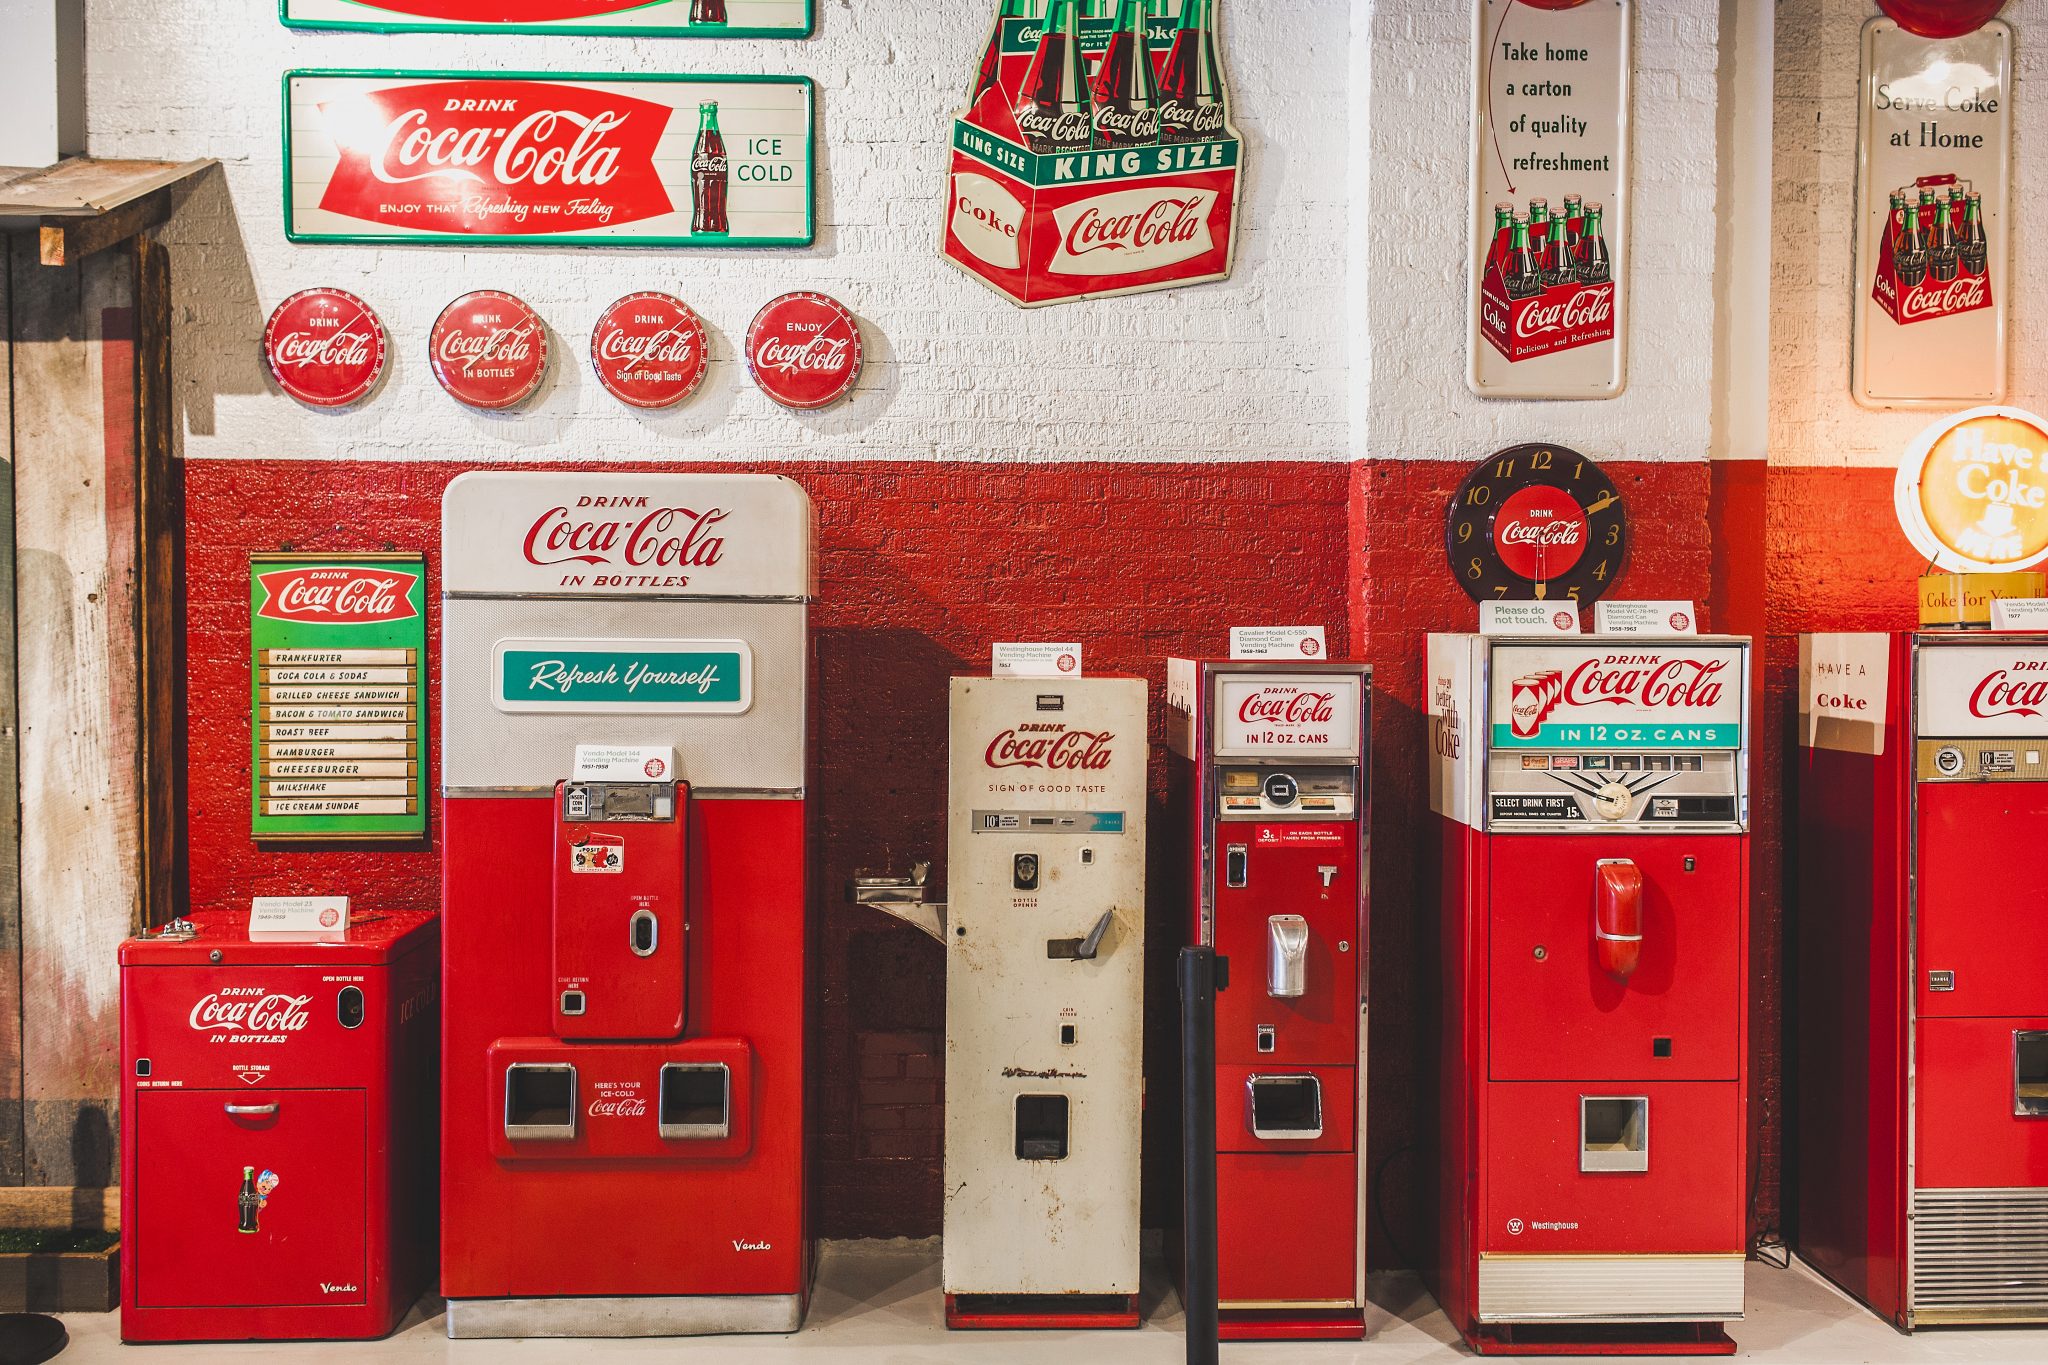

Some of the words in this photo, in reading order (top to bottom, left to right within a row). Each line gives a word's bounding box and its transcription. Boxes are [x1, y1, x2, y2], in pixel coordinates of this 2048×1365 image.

[1502, 42, 1538, 61] Take
[1545, 42, 1588, 61] home
[1506, 83, 1515, 96] a
[1522, 80, 1572, 97] carton
[443, 99, 518, 112] DRINK
[1876, 84, 1937, 111] Serve
[1944, 86, 1999, 113] Coke
[1017, 105, 1090, 141] Coca-Cola
[1509, 114, 1527, 133] of
[1531, 114, 1588, 138] quality
[1890, 129, 1911, 147] at
[1919, 121, 1984, 148] Home
[369, 108, 632, 185] Coca-Cola
[748, 139, 782, 155] ICE
[962, 131, 992, 156] KING
[996, 148, 1026, 172] SIZE
[1054, 151, 1142, 181] KING
[1156, 144, 1224, 171] SIZE
[1513, 152, 1610, 171] refreshment
[737, 165, 793, 182] COLD
[380, 204, 421, 214] ENJOY
[426, 204, 457, 213] THAT
[462, 195, 529, 222] Refreshing
[533, 205, 560, 214] NEW
[563, 198, 614, 223] Feeling
[958, 196, 1016, 239] Coke
[1065, 195, 1205, 256] Coca-Cola
[1876, 274, 1895, 300] Coke
[1902, 276, 1986, 318] Coca-Cola
[635, 315, 664, 324] DRINK
[1483, 302, 1507, 334] Coke
[1516, 286, 1613, 338] Coca-Cola
[309, 318, 340, 328] DRINK
[786, 323, 823, 332] ENJOY
[601, 328, 696, 362] Coca-Cola
[1516, 343, 1549, 356] Delicious
[1553, 337, 1568, 347] and
[1571, 328, 1611, 342] Refreshing
[463, 369, 474, 378] IN
[477, 368, 515, 378] BOTTLES
[616, 370, 633, 382] Sign
[635, 371, 642, 380] of
[643, 371, 662, 382] Good
[664, 371, 682, 381] Taste
[1952, 428, 2033, 468] Have
[1495, 459, 1515, 478] 11
[1529, 451, 1553, 470] 12
[1574, 461, 1583, 480] 1
[1467, 485, 1490, 506] 10
[1957, 464, 2046, 509] Coke
[576, 495, 650, 508] DRINK
[1529, 509, 1553, 518] DRINK
[523, 506, 733, 567] Coca-Cola
[1458, 522, 1472, 544] 9
[1606, 524, 1620, 545] 3
[1467, 557, 1482, 579] 8
[1592, 559, 1608, 581] 4
[559, 575, 586, 587] IN
[592, 575, 690, 587] BOTTLES
[278, 577, 400, 614] Coca-Cola
[1927, 591, 1957, 608] Coke
[1963, 591, 1986, 607] for
[1494, 606, 1531, 615] Please
[1531, 606, 1545, 615] do
[1494, 616, 1513, 624] not
[1515, 615, 1548, 624] touch.
[276, 654, 342, 662] FRANKFURTER
[1604, 655, 1662, 665] DRINK
[277, 672, 300, 680] COCA
[303, 672, 326, 680] COLA
[339, 671, 369, 680] SODAS
[529, 659, 620, 692] Refresh
[623, 660, 721, 695] Yourself
[1817, 663, 1851, 676] HAVE
[1858, 664, 1867, 676] A
[1563, 658, 1730, 707] Coca-Cola
[276, 691, 313, 699] GRILLED
[316, 691, 350, 699] CHEESE
[354, 691, 400, 699] SANDWICH
[1435, 686, 1452, 709] better
[1817, 693, 1868, 710] Coke
[275, 710, 305, 718] BACON
[317, 710, 353, 718] TOMATO
[355, 710, 404, 718] SANDWICH
[1238, 692, 1336, 723] Coca-Cola
[1442, 700, 1459, 730] with
[276, 728, 304, 736] ROAST
[308, 728, 330, 736] BEEF
[1018, 723, 1067, 732] DRINK
[1560, 730, 1581, 741] IN
[1590, 726, 1607, 741] 12
[1614, 730, 1647, 741] OZ.
[1653, 729, 1717, 741] CANS
[1246, 734, 1259, 744] IN
[1262, 731, 1274, 744] 12
[1277, 734, 1296, 744] OZ.
[1299, 734, 1329, 744] CANS
[1435, 718, 1460, 760] Coke
[276, 748, 335, 756] HAMBURGER
[985, 729, 1116, 770] Coca-Cola
[277, 765, 359, 774] CHEESEBURGER
[276, 783, 326, 791] MILKSHAKE
[989, 784, 1016, 793] SIGN
[1038, 785, 1071, 793] GOOD
[1076, 785, 1106, 793] TASTE
[275, 803, 290, 811] ICE
[292, 803, 323, 811] CREAM
[325, 802, 360, 810] SUNDAE
[1495, 798, 1520, 808] SELECT
[1522, 798, 1543, 808] DRINK
[1545, 798, 1565, 808] FIRST
[220, 987, 265, 996] DRINK
[189, 993, 314, 1031] Coca-Cola
[209, 1034, 226, 1043] IN
[229, 1034, 288, 1044] BOTTLES
[619, 1081, 641, 1089] YOUR
[588, 1098, 647, 1117] Coca-Cola
[1531, 1221, 1579, 1231] Westinghouse
[732, 1238, 771, 1252] Vendo
[320, 1281, 357, 1294] Vendo
